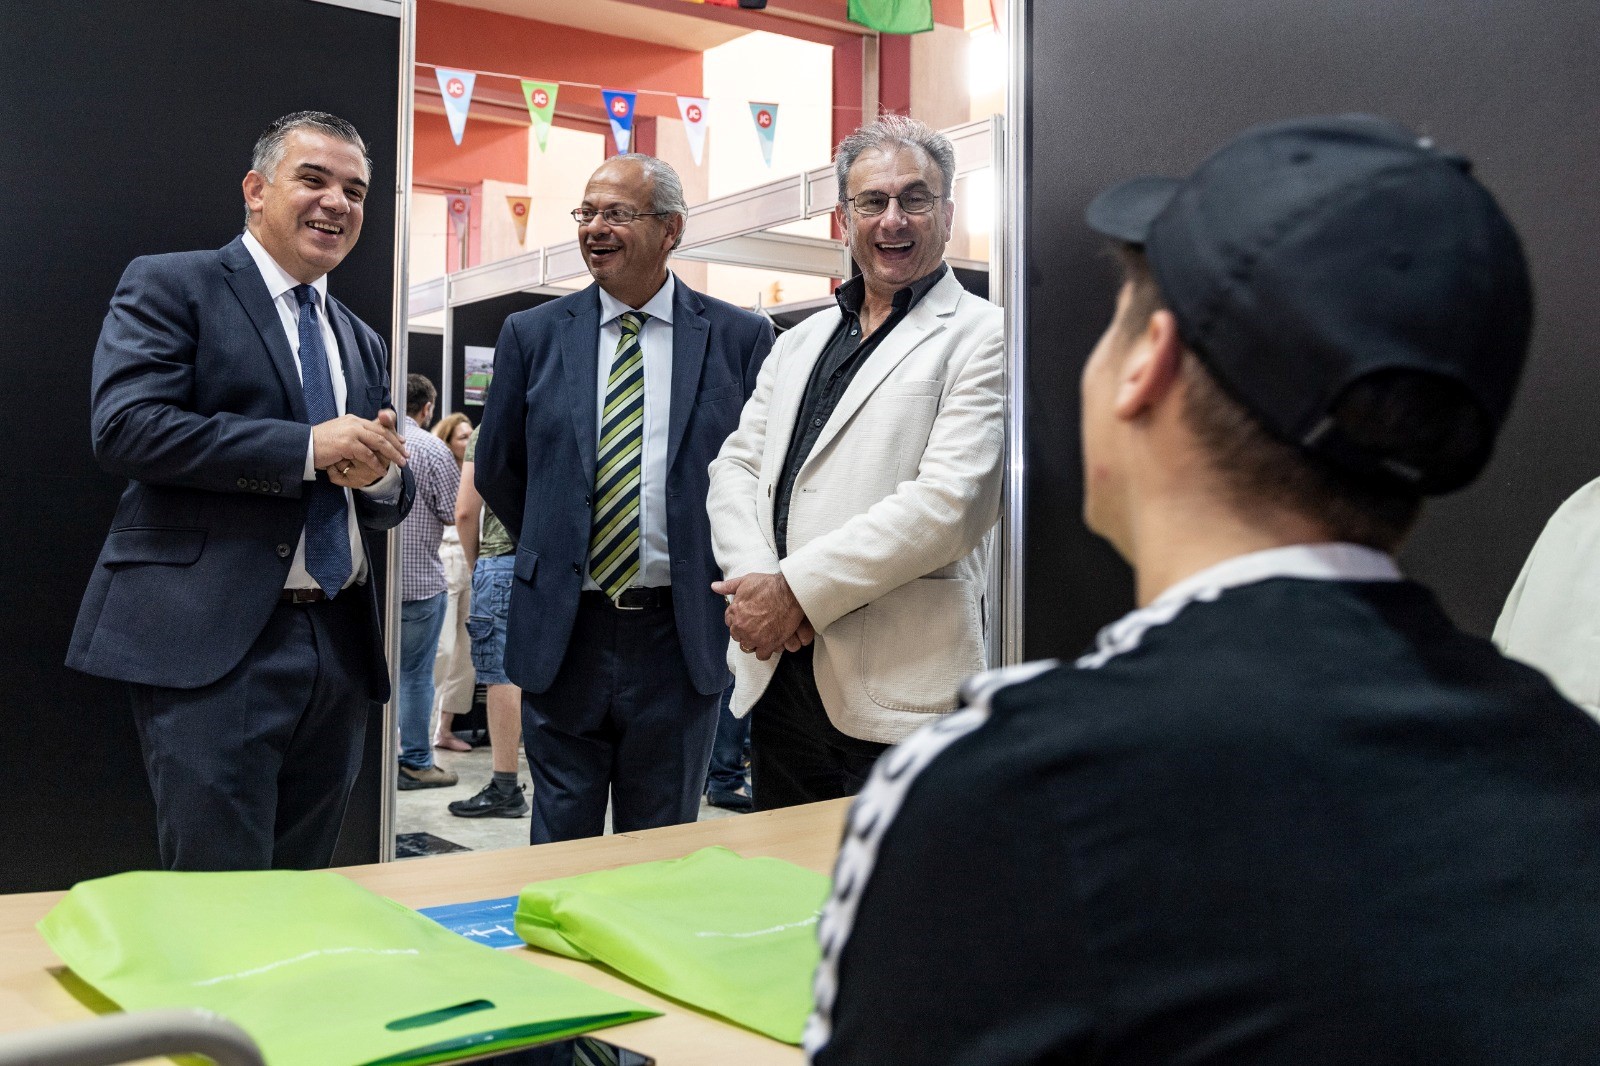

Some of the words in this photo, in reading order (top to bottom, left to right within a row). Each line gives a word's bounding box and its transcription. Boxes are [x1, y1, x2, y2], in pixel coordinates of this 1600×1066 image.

[449, 82, 463, 94] JC
[534, 93, 547, 105] JC
[613, 101, 626, 113] JC
[688, 108, 700, 119] JC
[759, 114, 770, 124] JC
